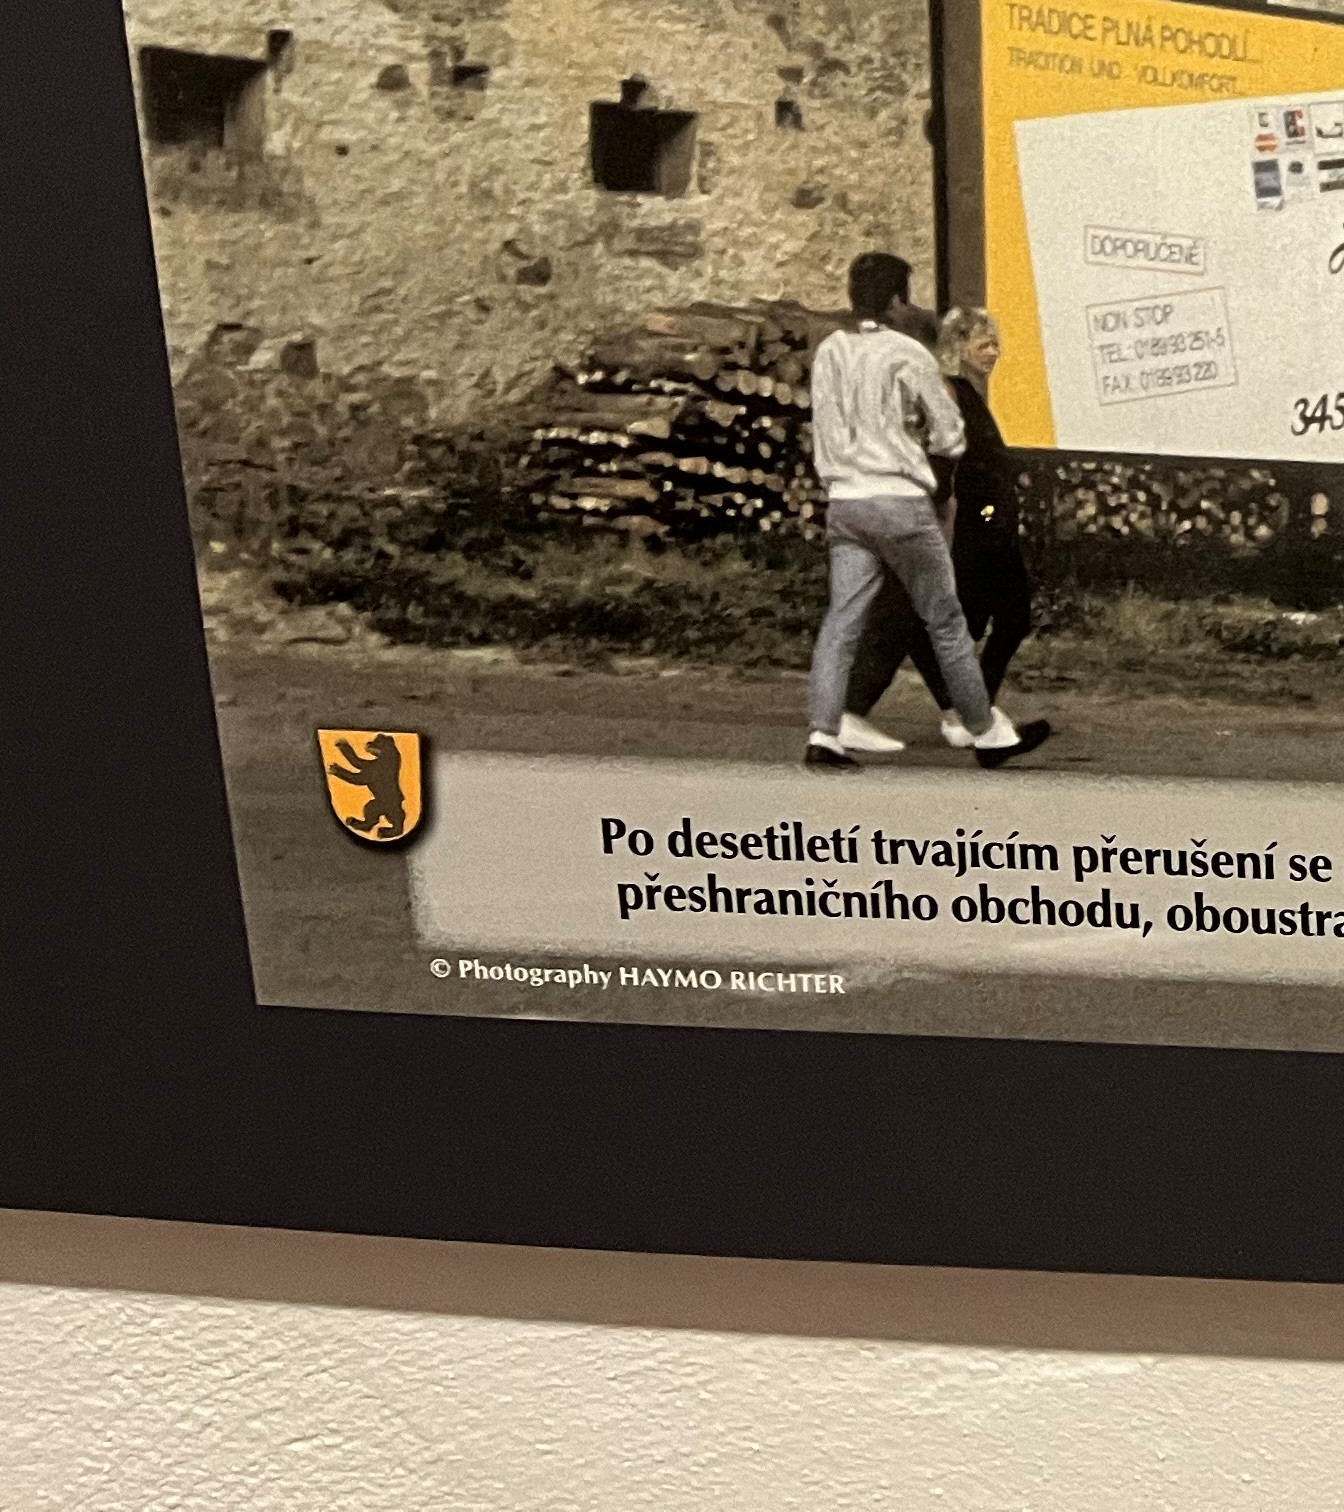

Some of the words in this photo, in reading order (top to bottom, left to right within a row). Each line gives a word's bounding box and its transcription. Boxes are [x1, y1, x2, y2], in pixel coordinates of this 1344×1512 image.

[1007, 3, 1097, 41] TRADICE
[1007, 46, 1084, 75] TRADITION
[1091, 59, 1121, 81] UND
[601, 818, 654, 856] Po
[667, 817, 860, 864] desetiletí
[871, 828, 1059, 878] trvajícím
[1072, 834, 1278, 883] přerušení
[1289, 854, 1332, 883] se
[617, 872, 939, 921] přeshraničního
[951, 883, 1153, 938] obchodu,
[458, 959, 612, 990] Photography
[619, 966, 722, 990] HAYMO
[730, 971, 846, 994] RICHTER
